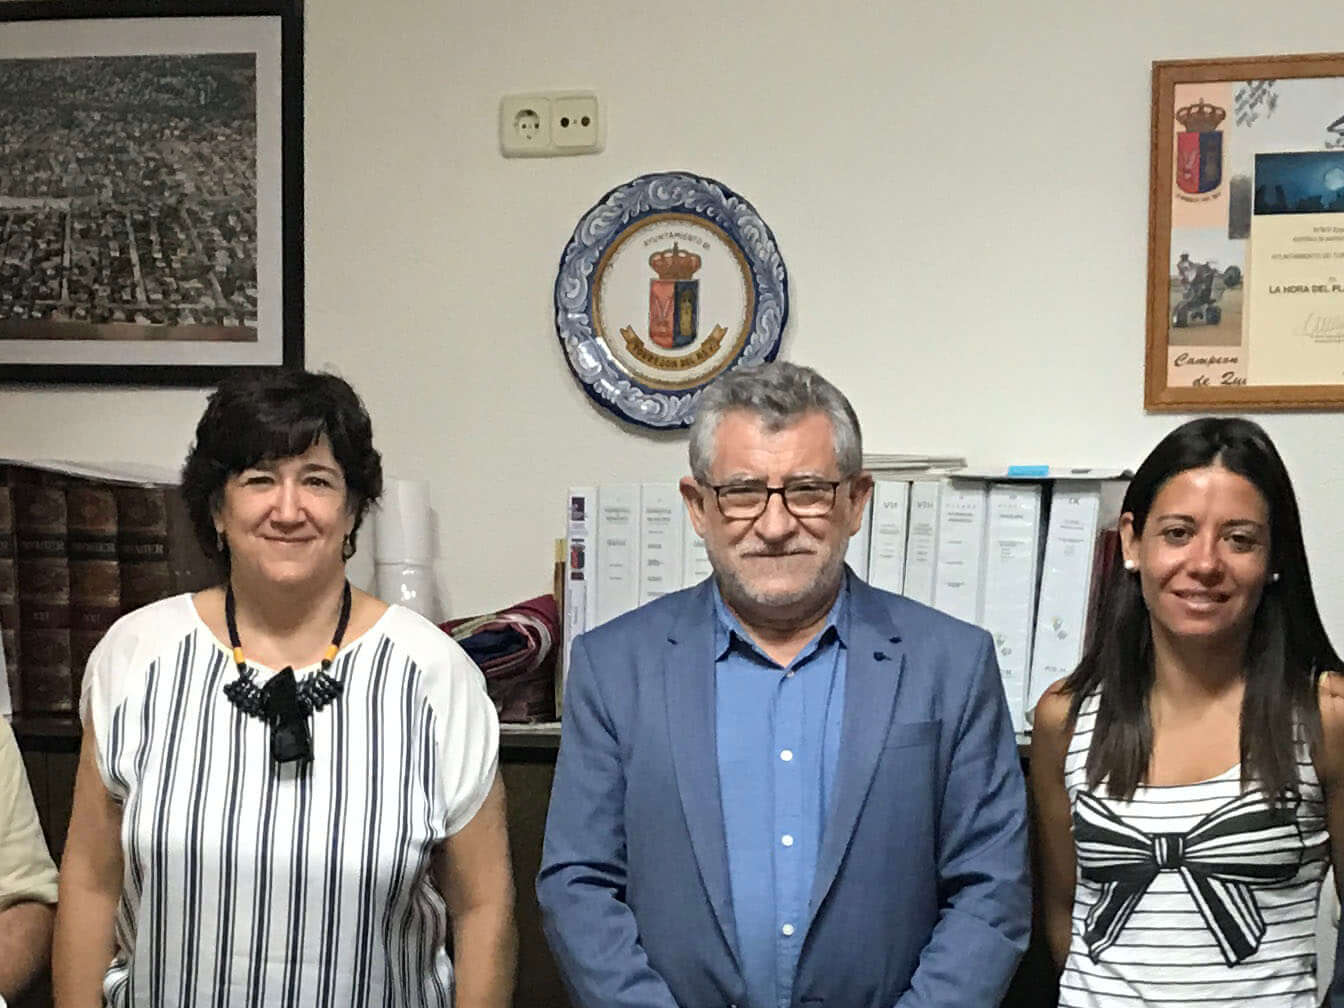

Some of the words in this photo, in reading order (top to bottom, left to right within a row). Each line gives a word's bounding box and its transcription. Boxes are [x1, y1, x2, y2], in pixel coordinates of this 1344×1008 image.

[1269, 285, 1281, 294] LA
[1283, 284, 1309, 294] HORA
[1312, 284, 1330, 293] DEL
[1174, 352, 1239, 367] Campeon
[1192, 374, 1210, 387] de
